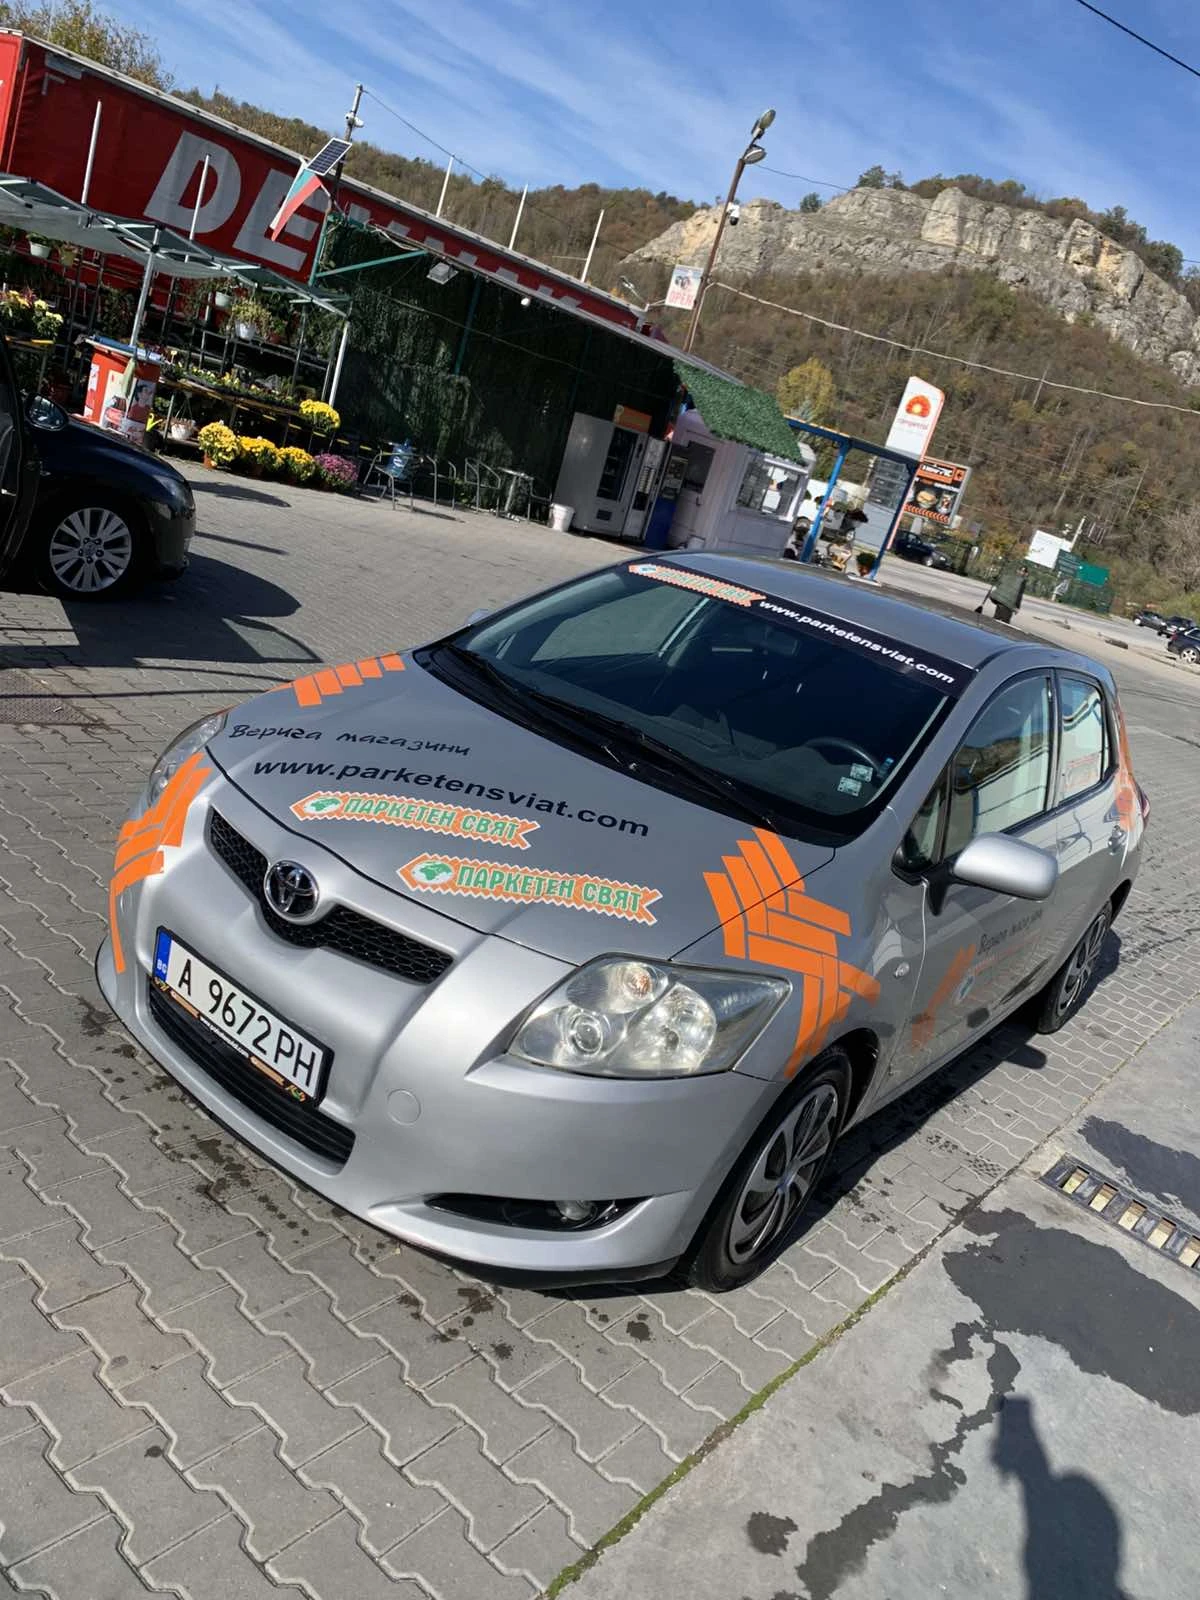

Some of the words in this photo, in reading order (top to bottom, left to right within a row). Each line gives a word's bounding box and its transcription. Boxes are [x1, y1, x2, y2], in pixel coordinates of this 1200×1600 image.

[759, 601, 954, 684] www.parketensviat.com
[229, 724, 322, 740] Верига
[335, 731, 470, 756] магазини
[253, 761, 649, 837] www.parketensviat.com
[343, 798, 457, 828] ПАРКЕТЕН
[461, 814, 519, 840] СВЯТ
[456, 864, 575, 898] ПАРКЕТЕН
[582, 881, 641, 913] СВЯТ
